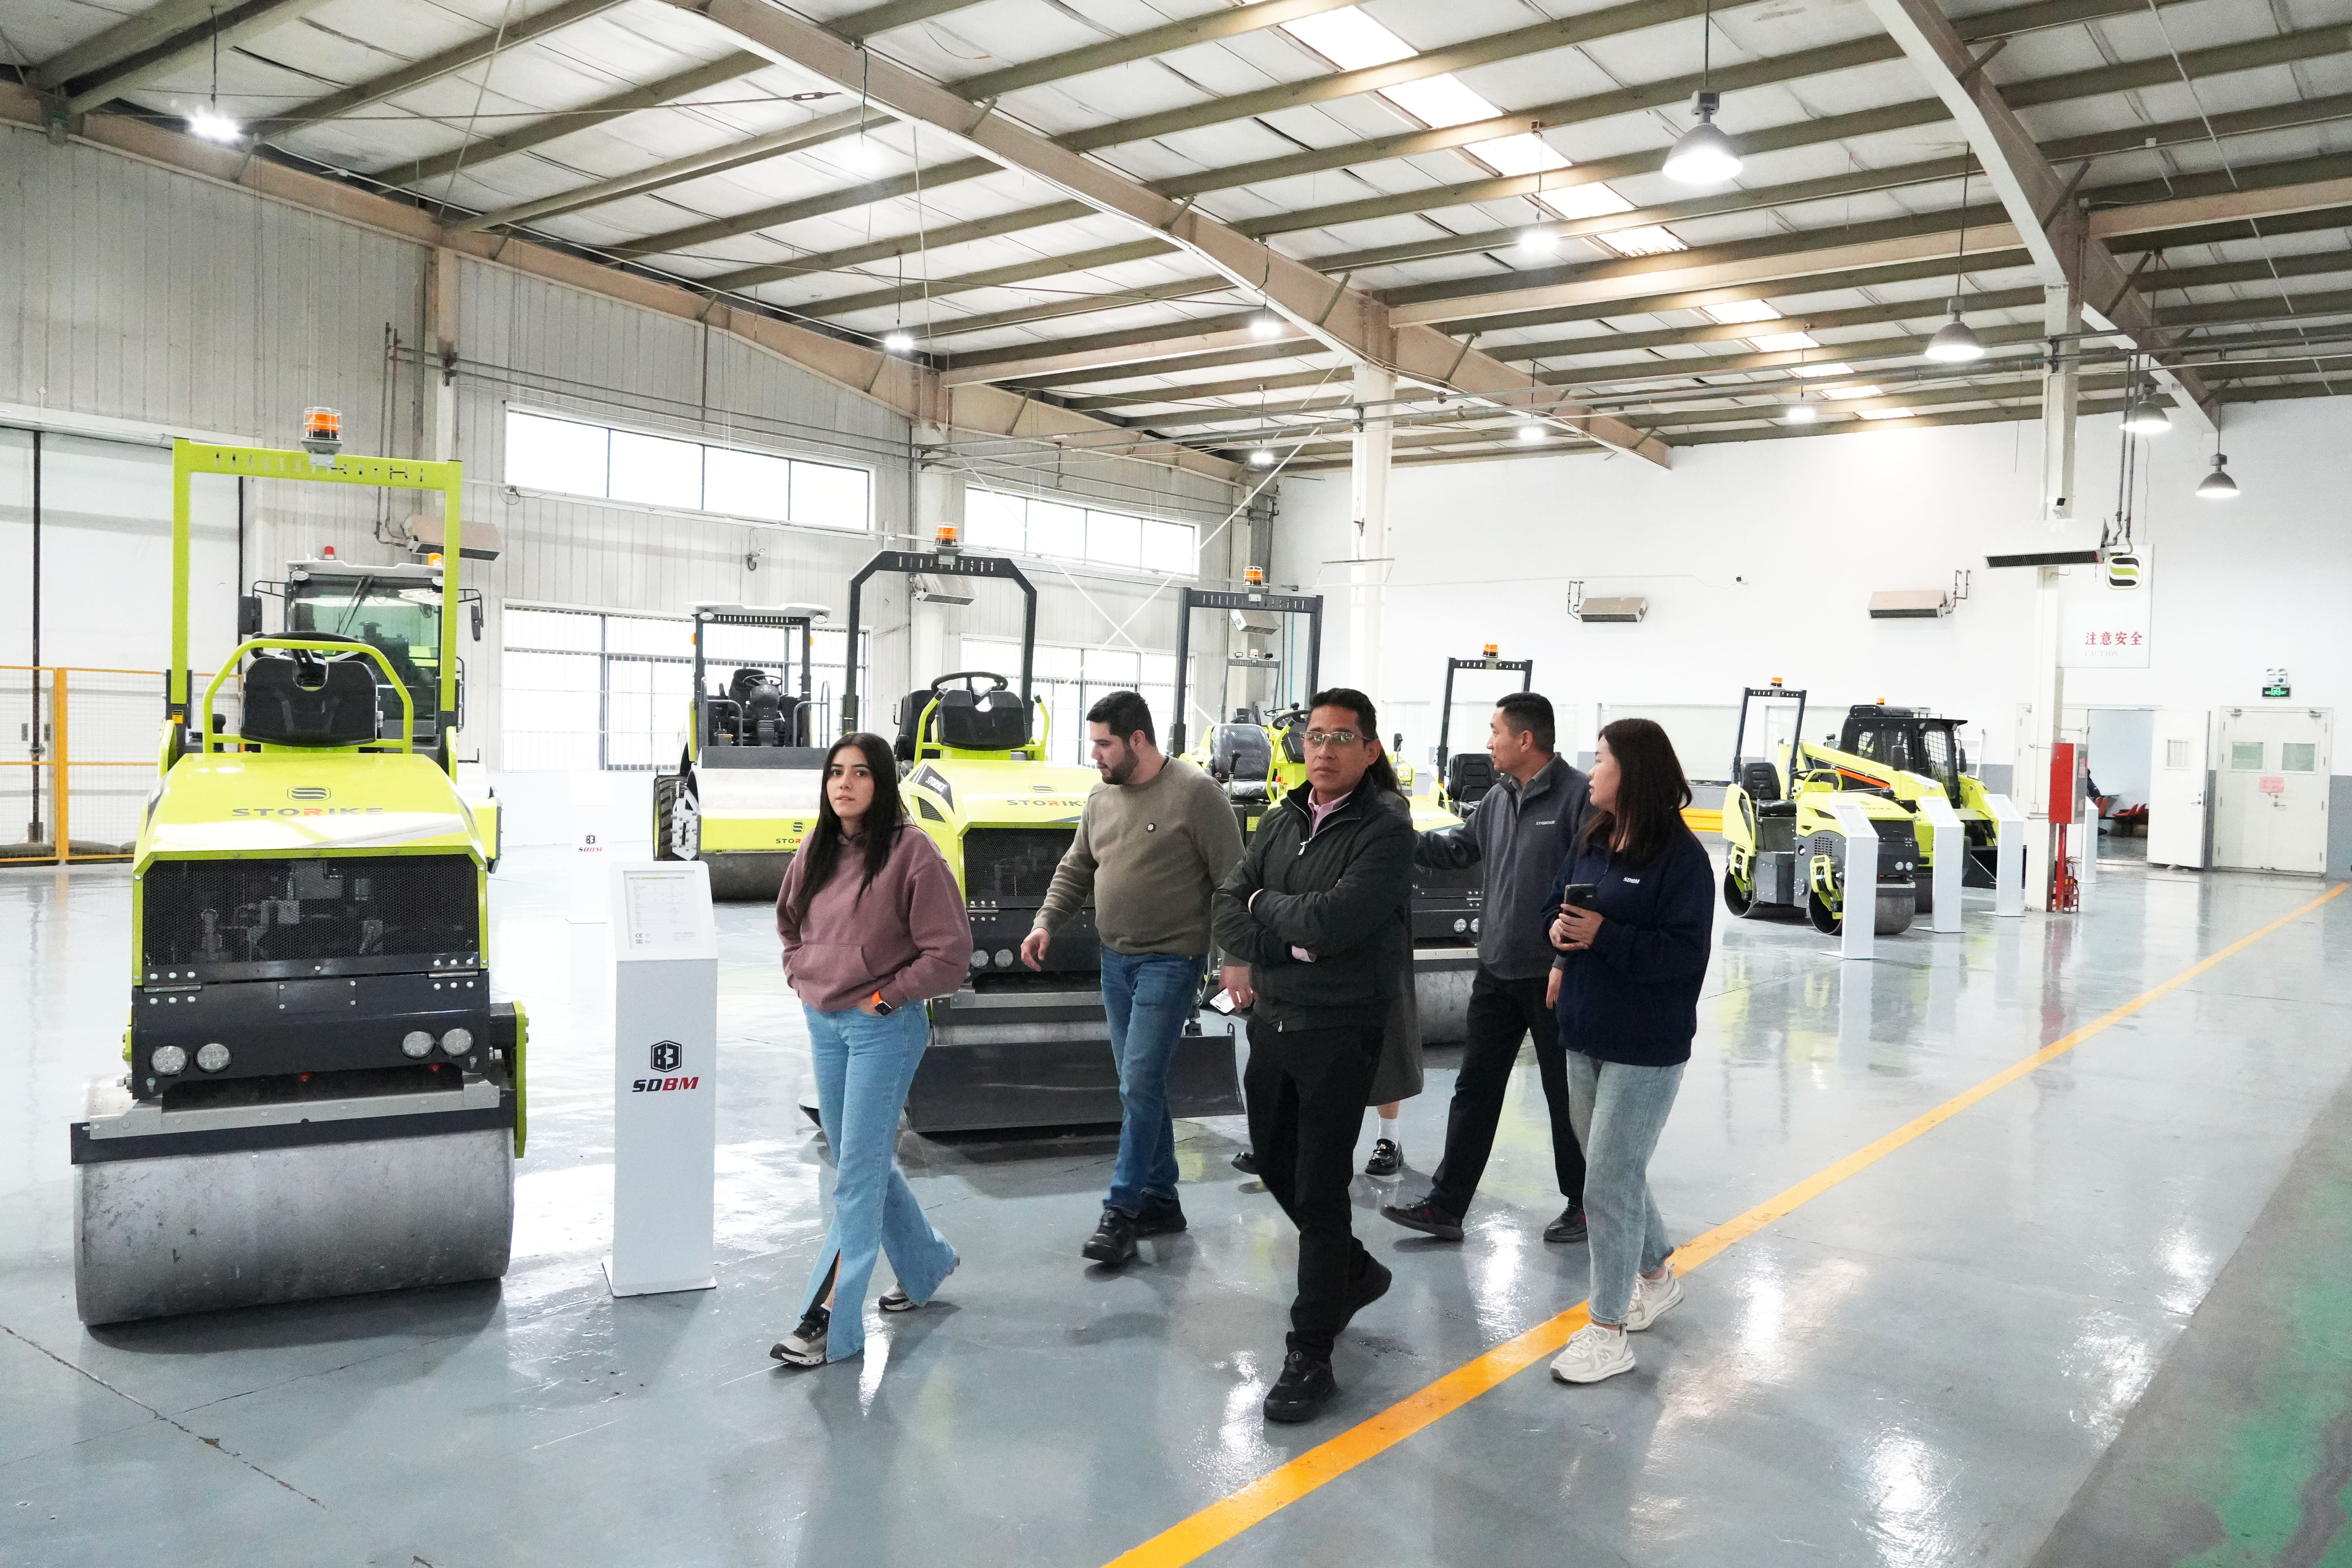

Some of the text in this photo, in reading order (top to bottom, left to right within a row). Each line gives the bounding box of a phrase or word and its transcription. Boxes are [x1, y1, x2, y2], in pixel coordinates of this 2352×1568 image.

[2085, 632, 2142, 645] 注意安全
[231, 808, 383, 817] STORIKE
[632, 1077, 699, 1092] SDBM
